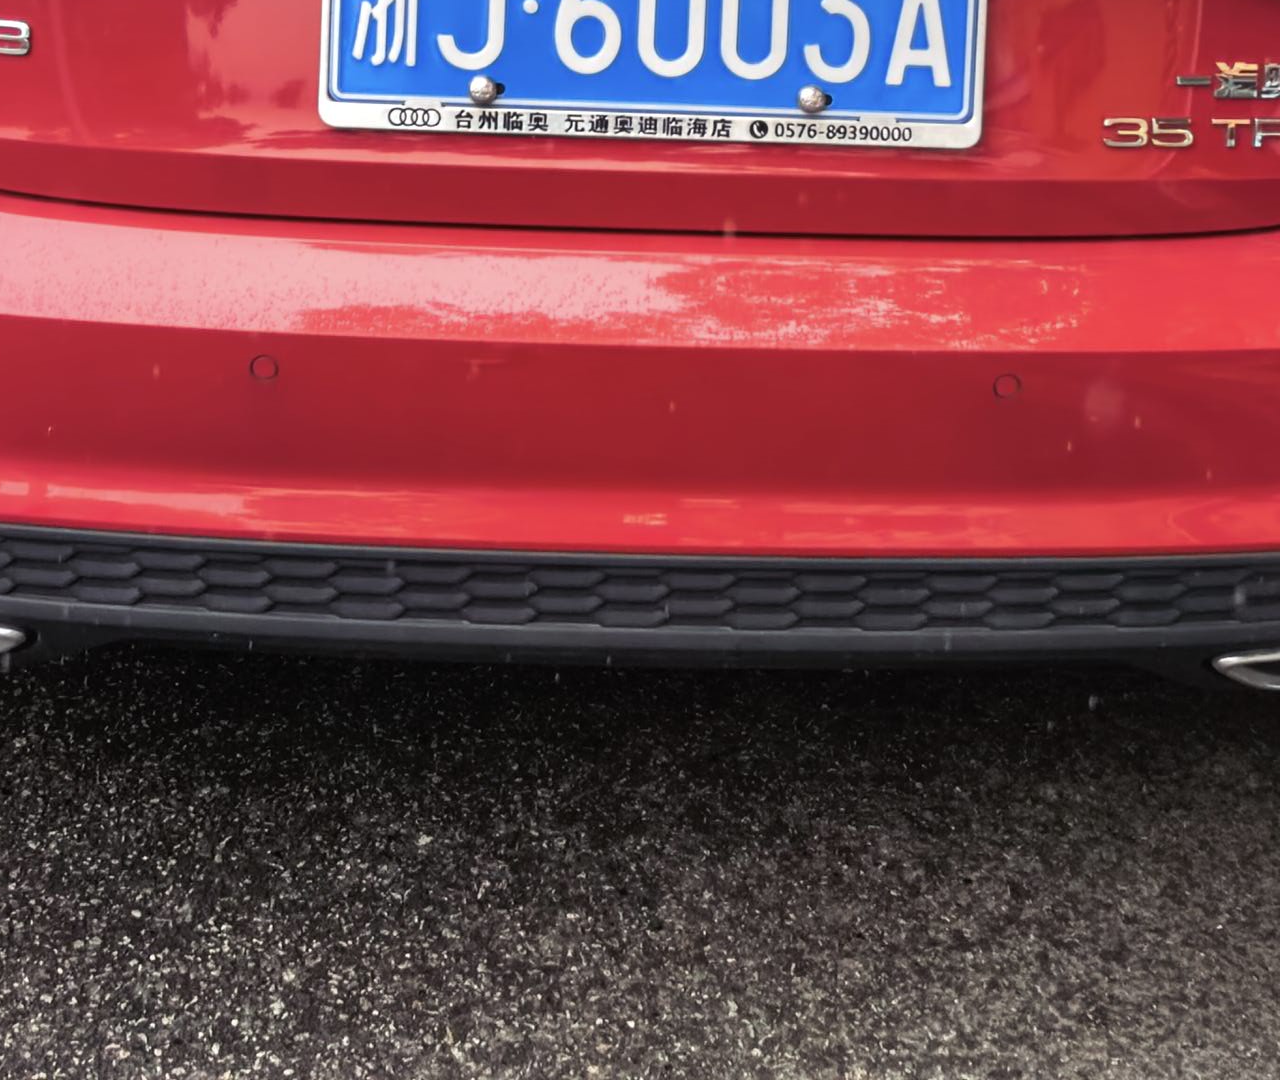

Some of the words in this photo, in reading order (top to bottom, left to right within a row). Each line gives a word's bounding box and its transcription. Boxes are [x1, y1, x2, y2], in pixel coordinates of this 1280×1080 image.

[454, 109, 549, 132] 台州临奥
[564, 115, 732, 139] 元通奥迪临海店
[773, 123, 913, 142] 0576-89390000
[1103, 118, 1194, 148] 35
